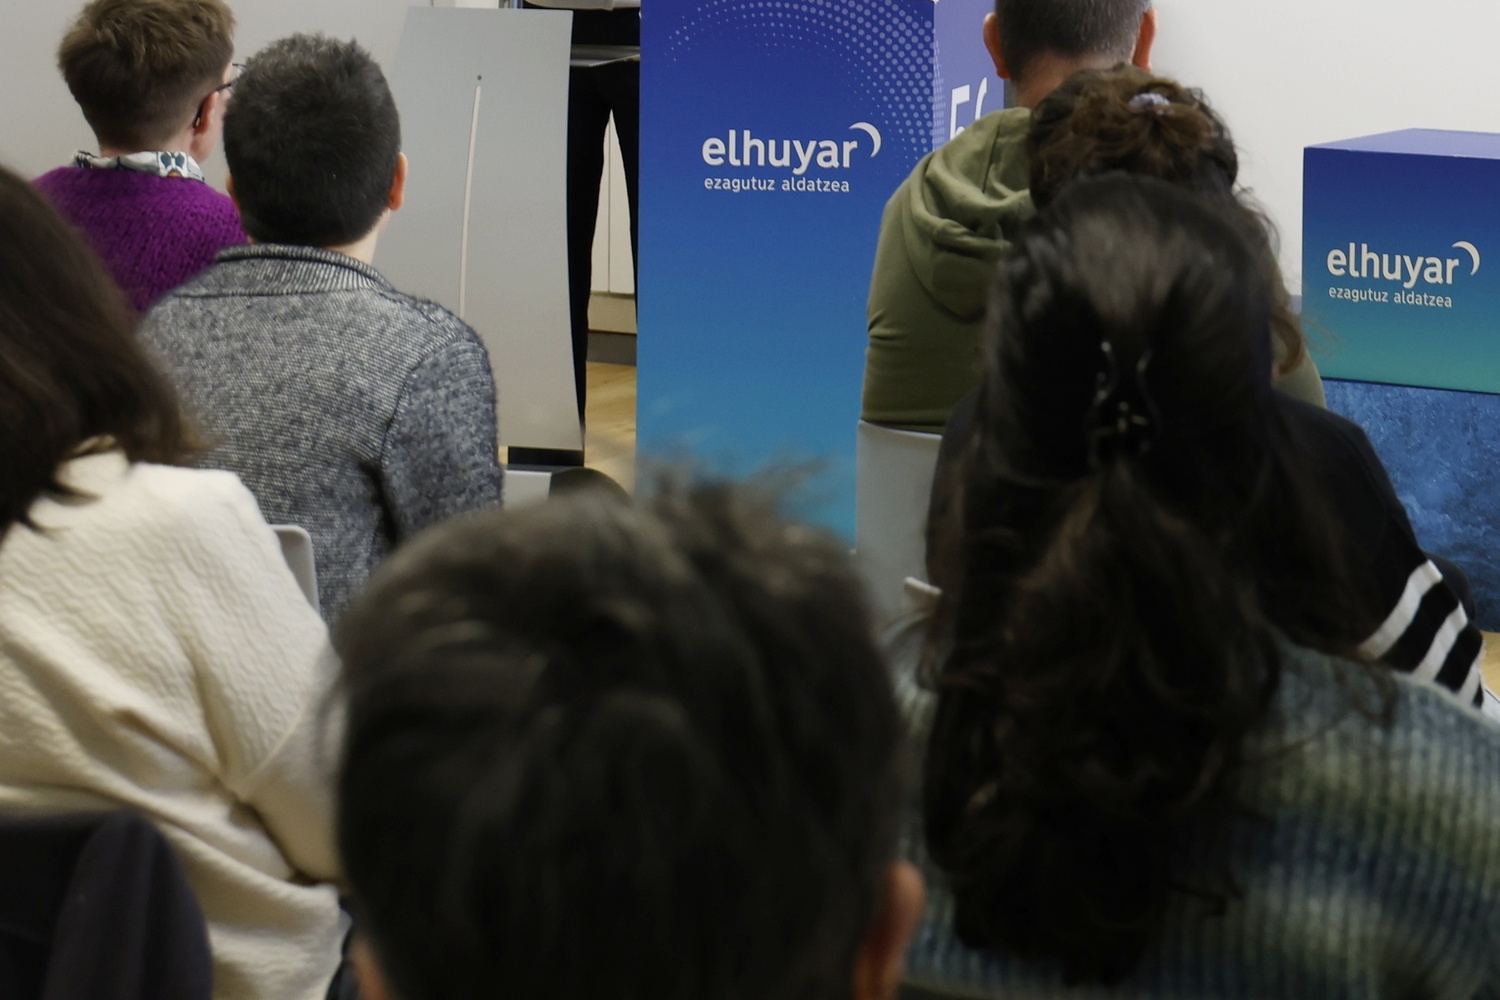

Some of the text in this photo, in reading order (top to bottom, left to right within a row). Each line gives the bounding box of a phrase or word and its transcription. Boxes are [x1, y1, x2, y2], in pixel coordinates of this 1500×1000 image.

[702, 129, 858, 175] elhuyar
[703, 175, 850, 194] ezagutuz aldatzea
[1327, 242, 1459, 289] elhuyar
[1328, 285, 1453, 308] ezagutuz aldatzea
